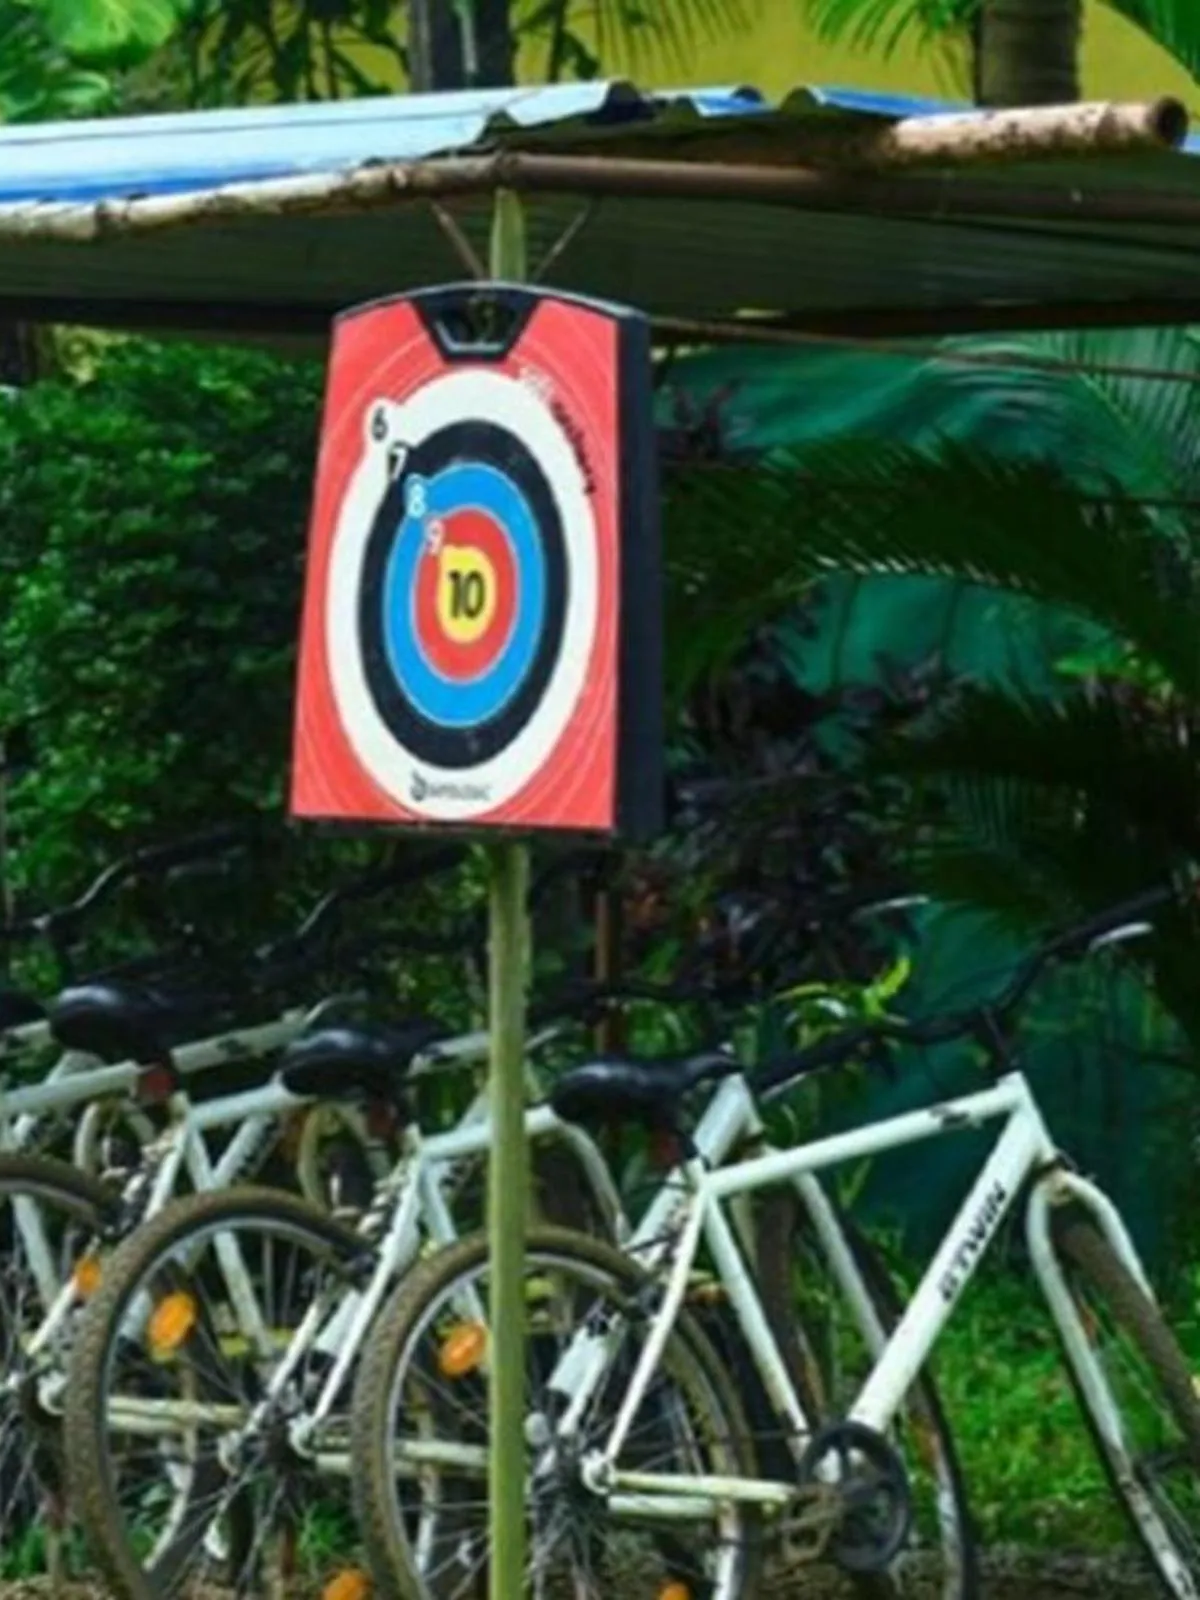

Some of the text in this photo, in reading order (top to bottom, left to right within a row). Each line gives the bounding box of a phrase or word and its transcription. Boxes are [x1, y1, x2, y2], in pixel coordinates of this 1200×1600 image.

[371, 406, 388, 443] 6
[407, 482, 427, 519] 8
[426, 518, 446, 556] 9
[448, 569, 486, 620] 10
